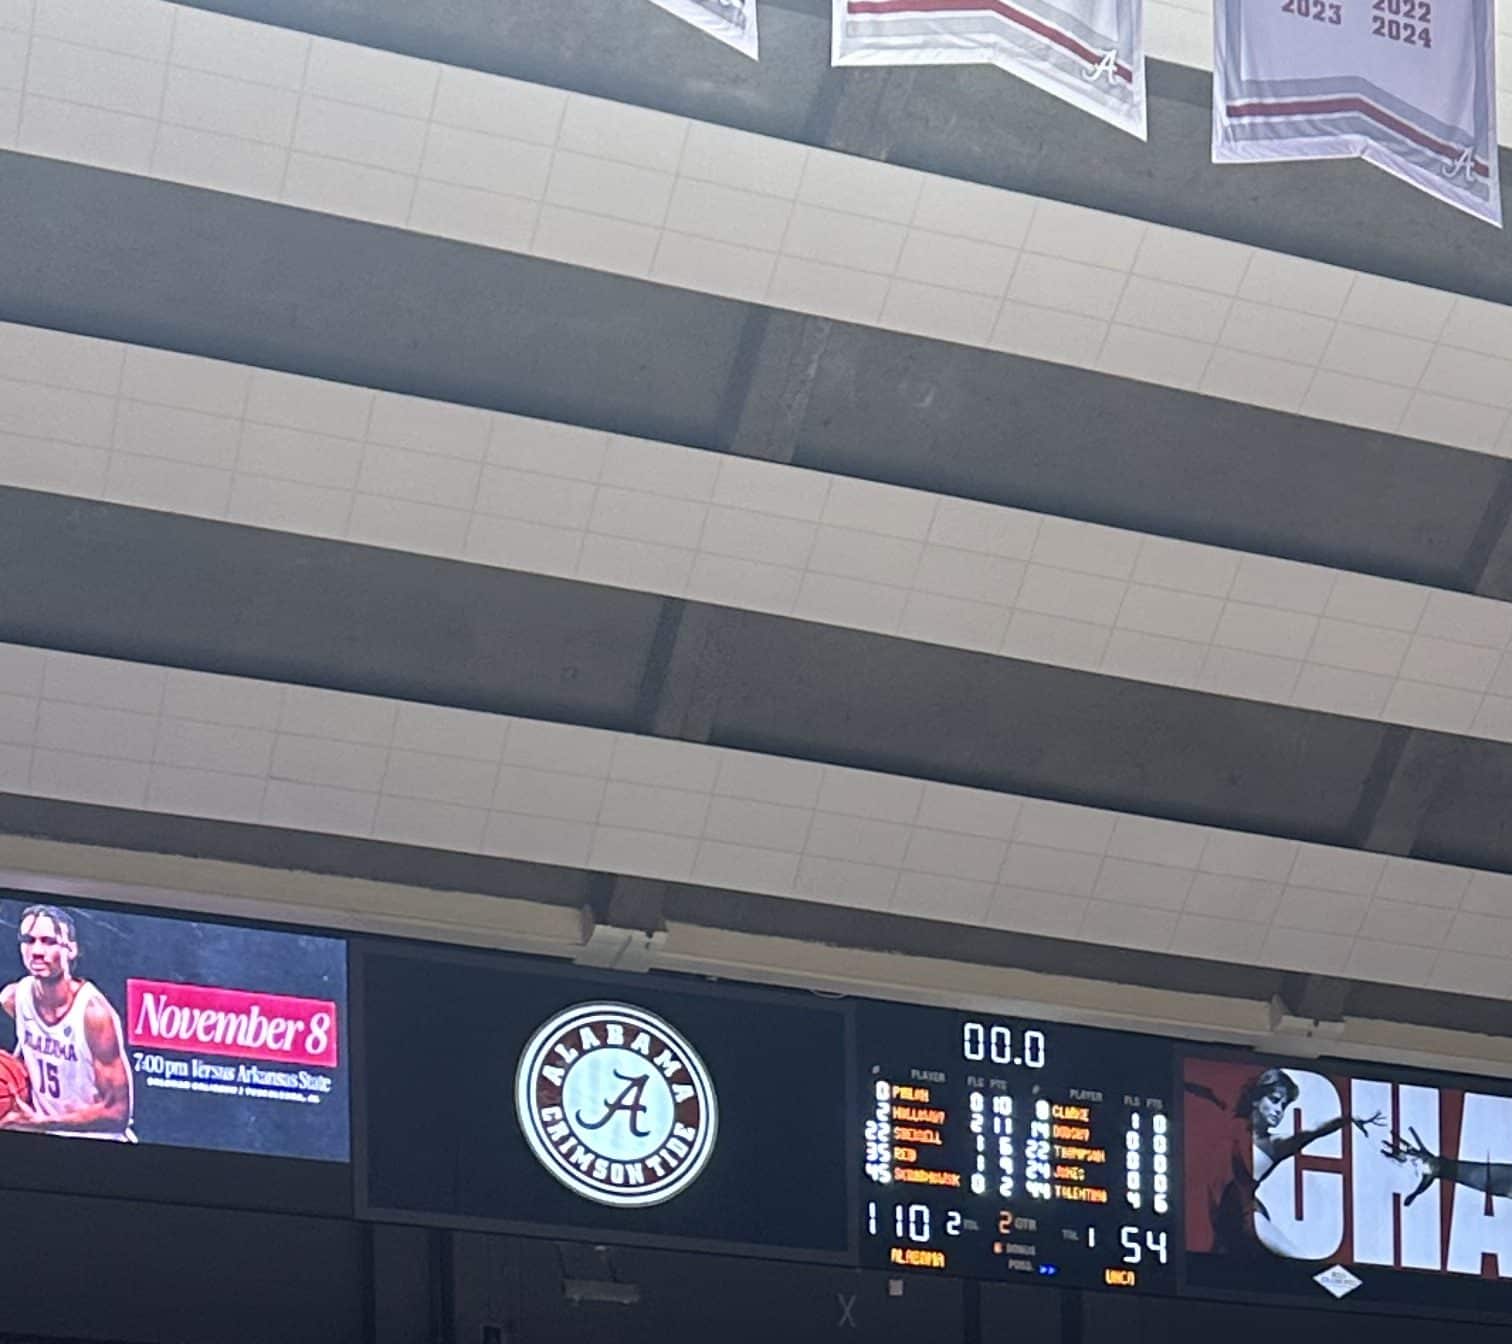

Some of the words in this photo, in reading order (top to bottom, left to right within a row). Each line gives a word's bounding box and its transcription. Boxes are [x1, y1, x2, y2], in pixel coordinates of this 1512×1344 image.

[1372, 16, 1432, 48] 2024
[134, 992, 305, 1052] November
[305, 1012, 330, 1055] 8
[541, 1023, 696, 1104] ALABAMA
[963, 1022, 1046, 1069] 00.0
[37, 1058, 60, 1099] 15
[133, 1053, 164, 1072] 7:00
[237, 1064, 299, 1088] Arkansas
[541, 1105, 645, 1185] CRIMSON
[645, 1121, 696, 1178] TIDE
[864, 1119, 892, 1143] 22
[945, 1210, 962, 1236] 2
[998, 1210, 1013, 1235] 2
[1120, 1225, 1168, 1264] 54
[837, 1292, 857, 1328] X
